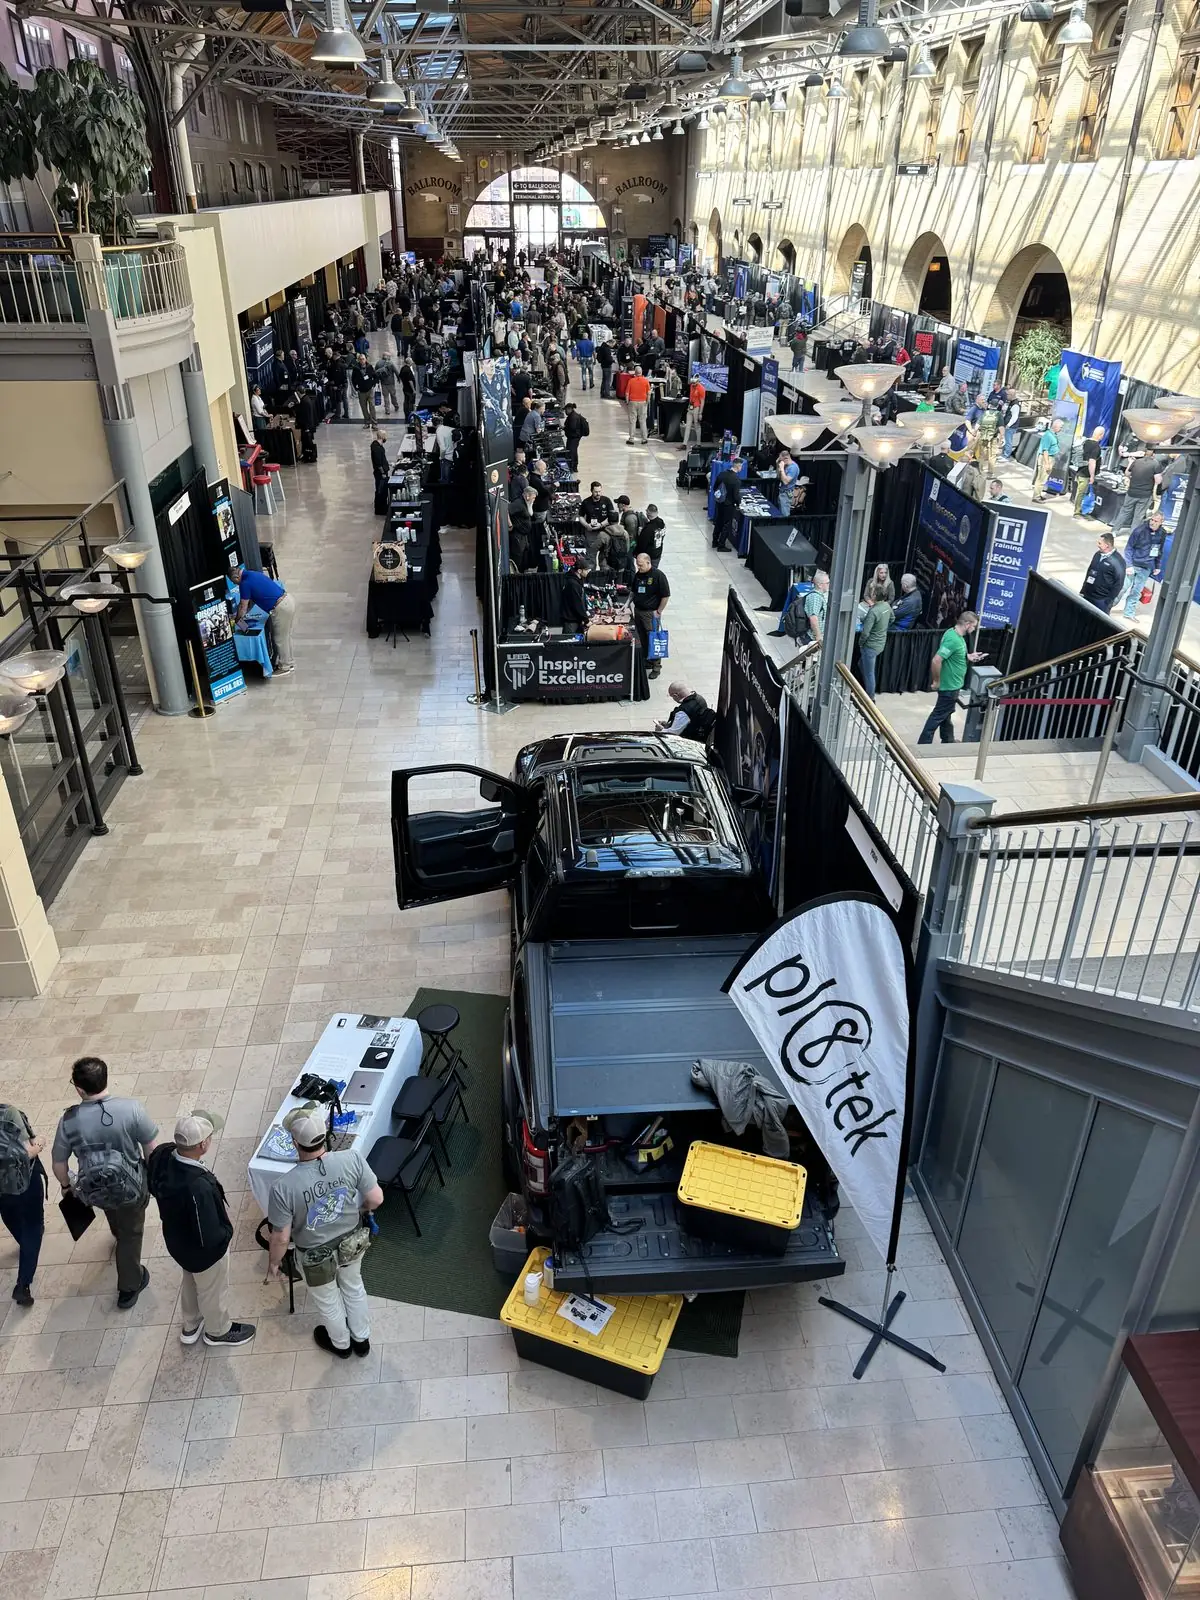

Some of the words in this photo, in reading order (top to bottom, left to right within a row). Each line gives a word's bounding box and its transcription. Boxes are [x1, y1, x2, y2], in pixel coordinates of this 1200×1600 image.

[407, 177, 461, 196] BALLROOM
[615, 176, 668, 195] BALLROOM
[538, 655, 597, 674] Inspire
[538, 670, 624, 685] Excellence
